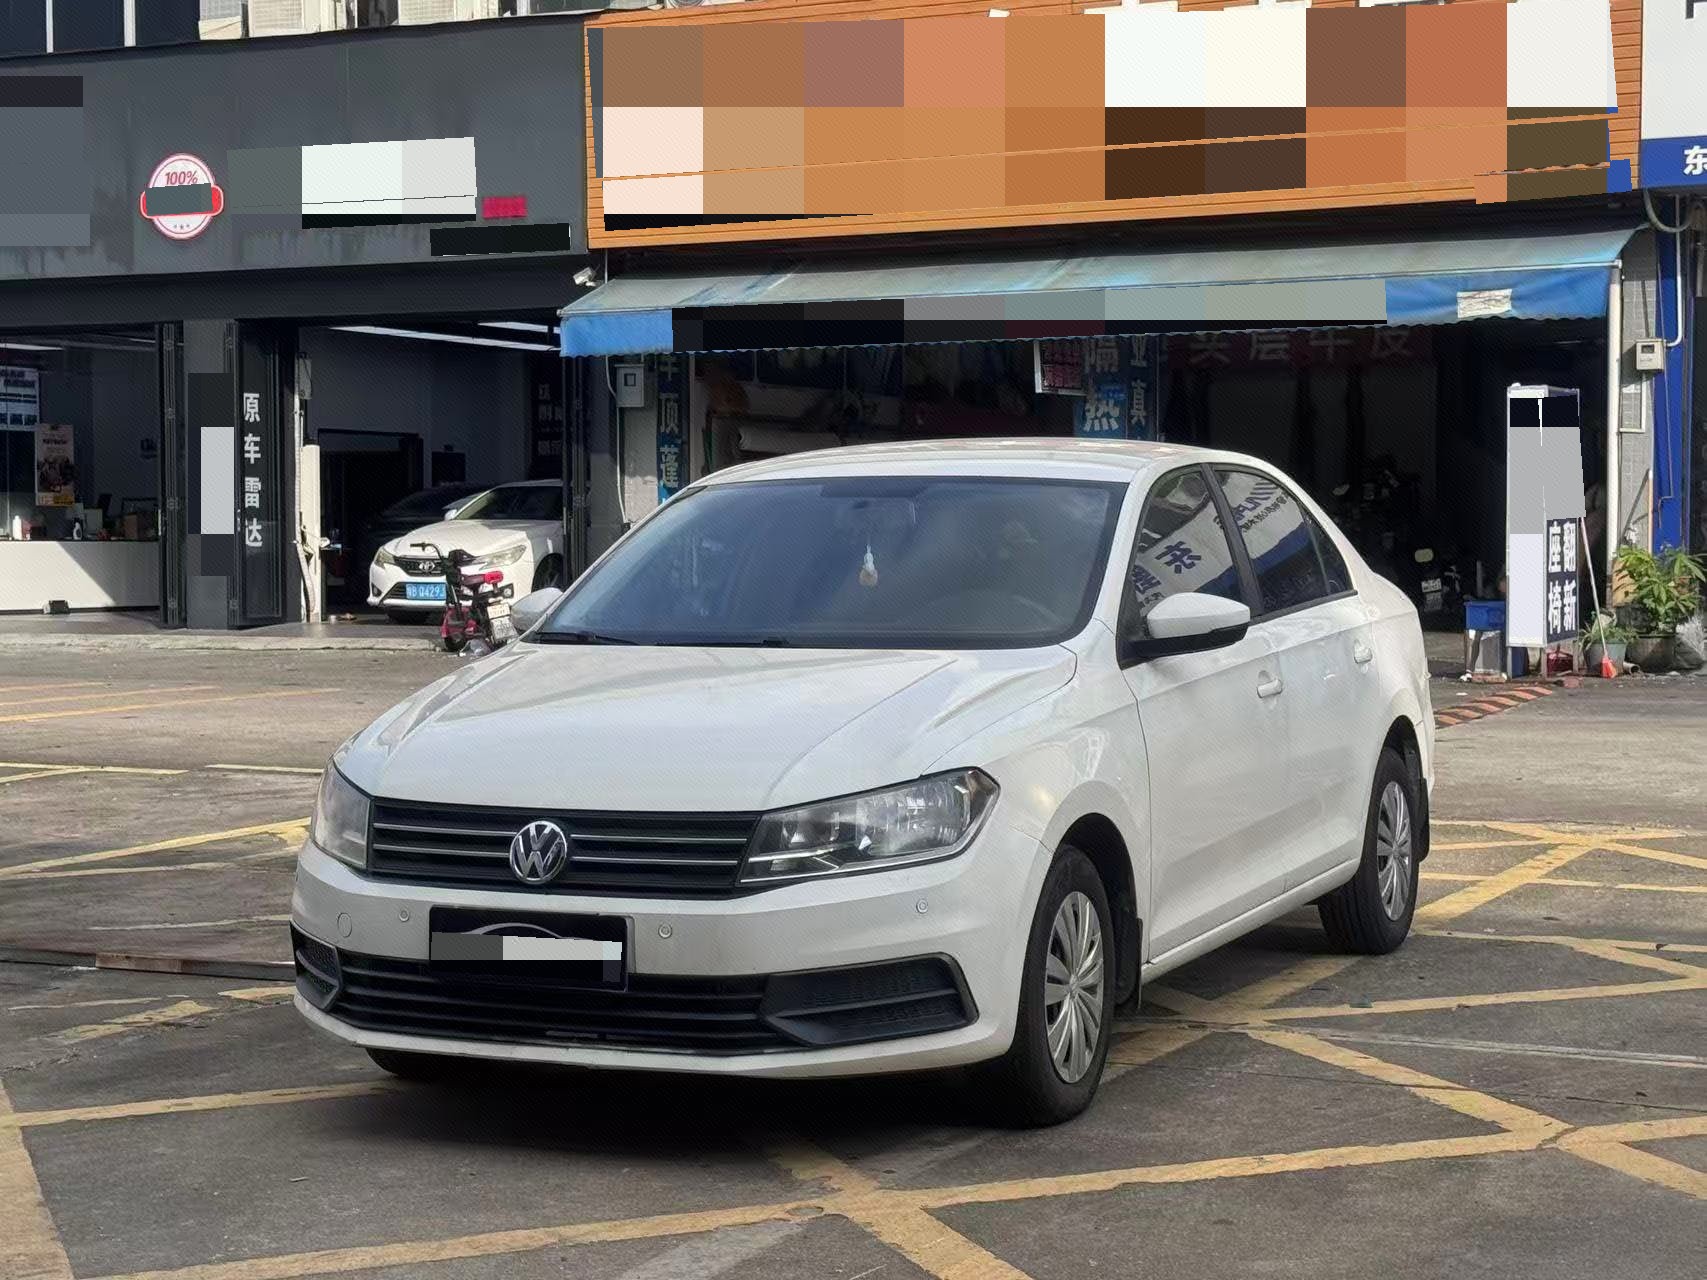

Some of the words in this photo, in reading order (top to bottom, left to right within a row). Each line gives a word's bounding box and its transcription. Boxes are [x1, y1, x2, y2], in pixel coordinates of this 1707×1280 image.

[165, 170, 199, 186] 100%
[243, 392, 263, 548] 原车雷达
